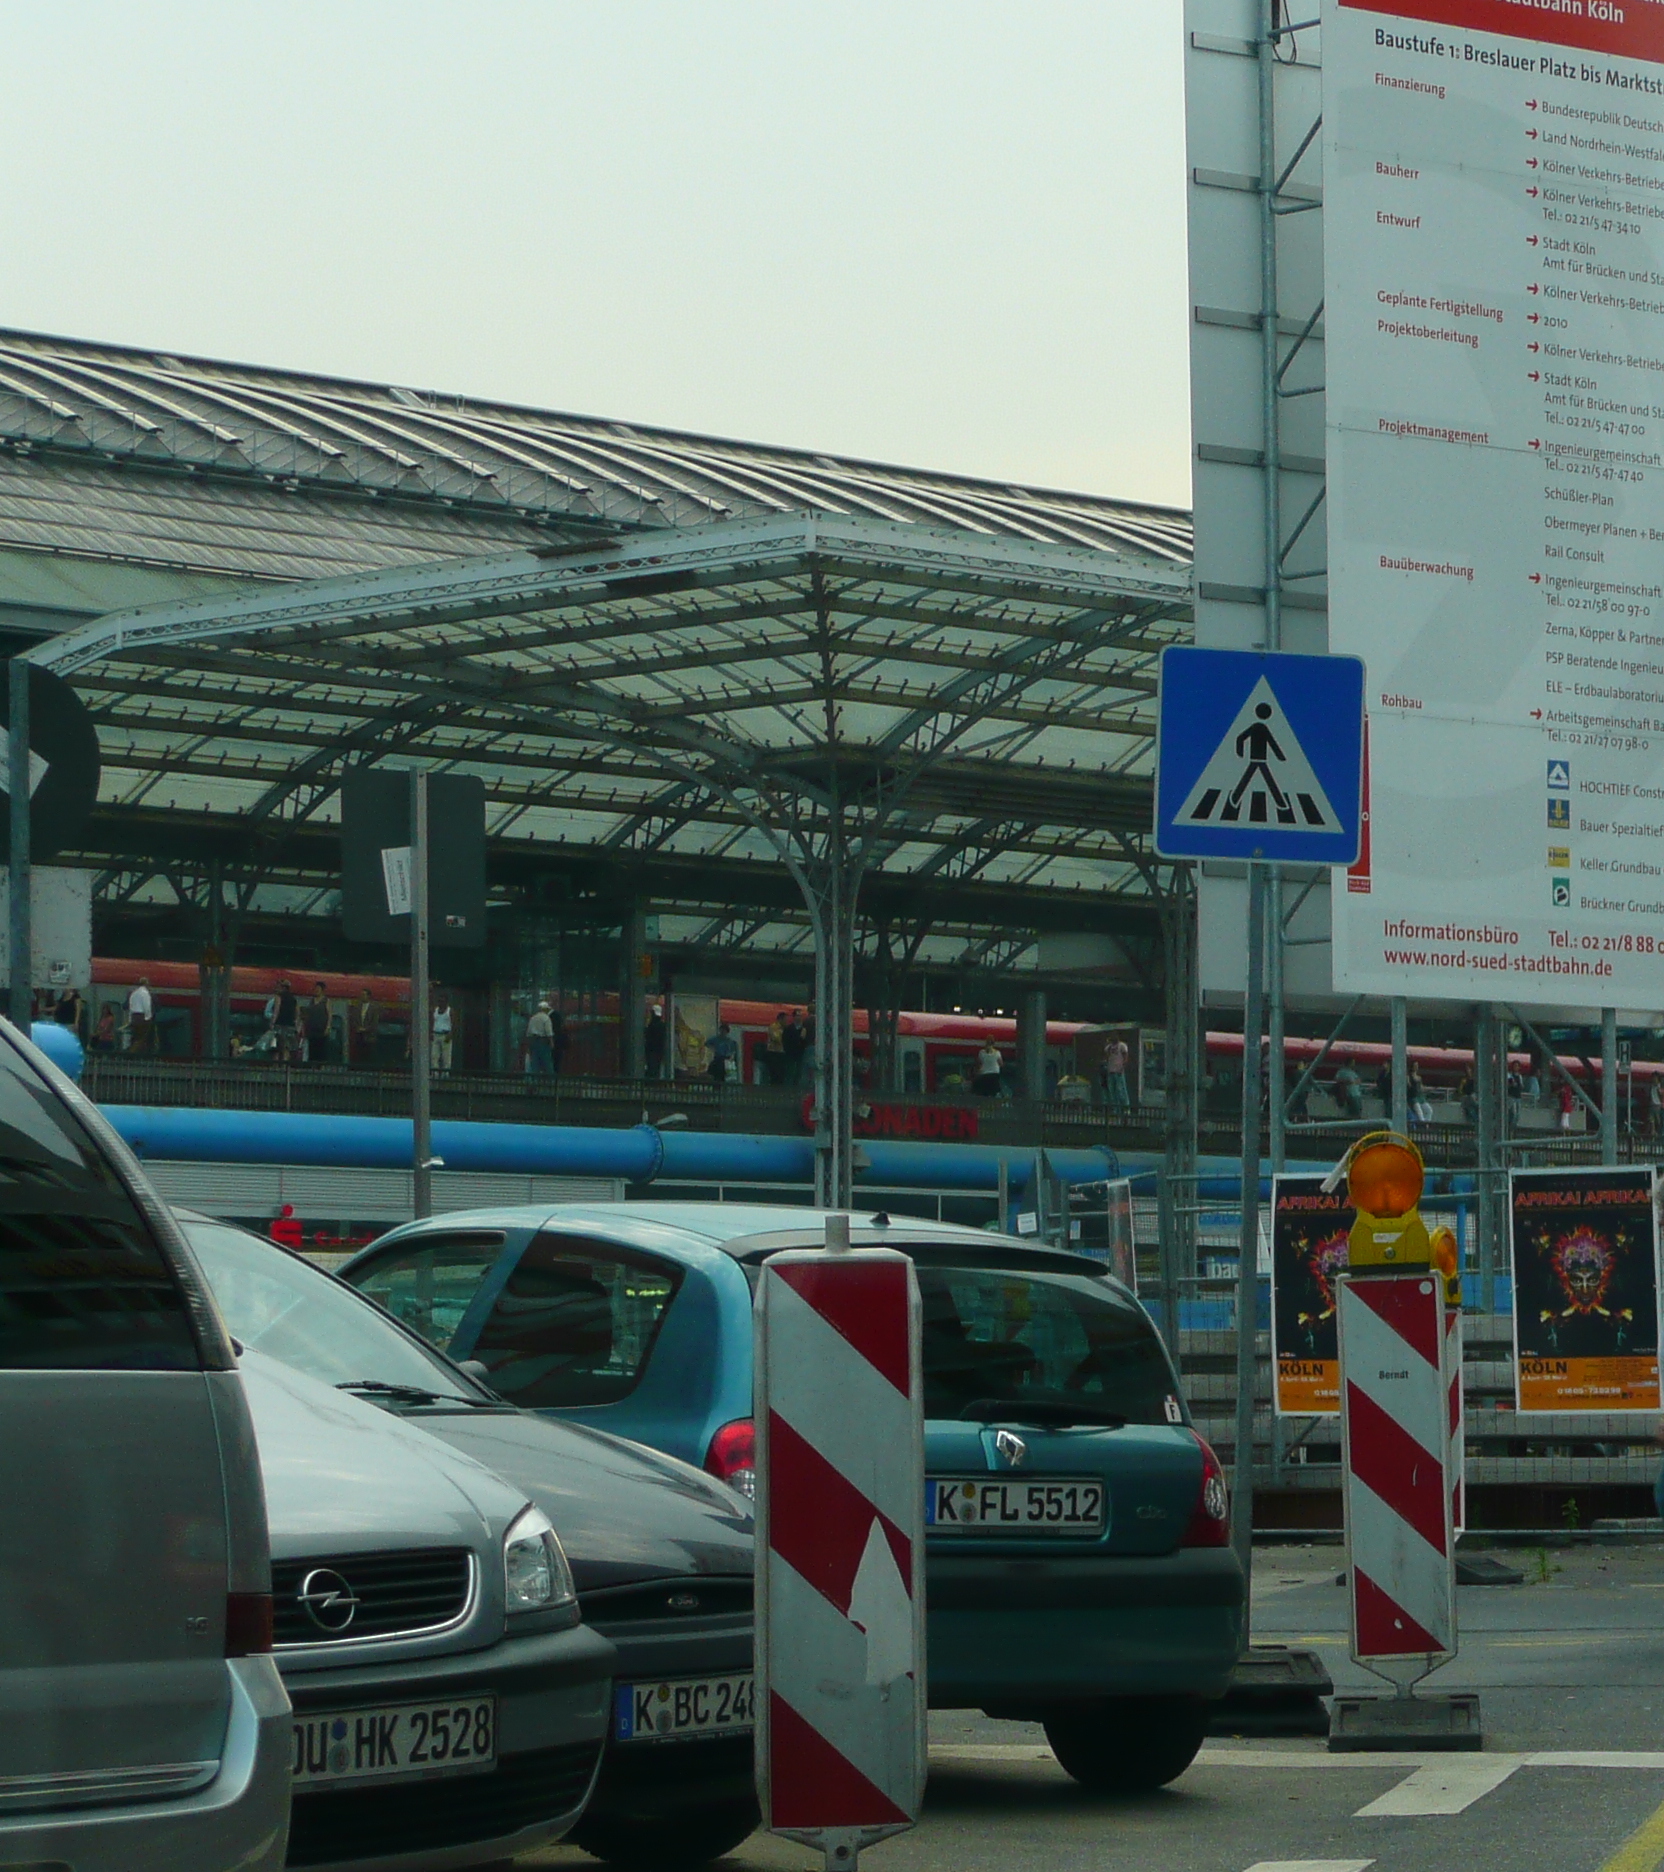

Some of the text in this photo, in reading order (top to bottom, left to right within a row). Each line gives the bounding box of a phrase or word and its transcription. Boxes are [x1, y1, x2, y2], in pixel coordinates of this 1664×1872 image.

[1588, 1, 1624, 24] Köln
[1375, 28, 1445, 57] Baustufe
[1449, 44, 1460, 60] 1:
[1464, 43, 1536, 73] Breslauer
[1540, 57, 1576, 79] Platz
[1581, 62, 1601, 84] bis
[1375, 72, 1446, 99] Finanzierung
[1542, 100, 1621, 126] Bundesrepublik
[1542, 130, 1567, 146] Land
[1376, 161, 1419, 180] Bauherr
[1542, 158, 1575, 176] Kölner
[1542, 187, 1575, 205] Kölner
[1376, 211, 1421, 229] Entwurf
[1542, 207, 1563, 222] Tel.:
[1564, 213, 1577, 224] 02
[1543, 236, 1596, 256] Stadt Köln
[1543, 256, 1565, 271] Amt
[1568, 259, 1583, 274] für
[1586, 263, 1626, 280] Brücken
[1629, 270, 1648, 283] und
[1543, 284, 1577, 301] Kölner
[1377, 290, 1504, 323] Geplante Fertigstellung
[1544, 316, 1568, 329] 2010
[1378, 319, 1479, 349] Projektoberleitung
[1544, 343, 1576, 359] Kölner
[1544, 372, 1597, 390] Stadt Köln
[1544, 391, 1566, 406] Amt
[1569, 394, 1584, 408] für
[1587, 397, 1627, 414] Brücken
[1630, 405, 1649, 417] und
[1544, 411, 1565, 426] Tel.:
[1567, 416, 1579, 427] 02
[1379, 418, 1489, 445] Projektmanagement
[1545, 440, 1661, 466] Ingenieurgemeinschaft
[1567, 463, 1579, 473] 02
[1544, 516, 1601, 536] Obermeyer
[1603, 522, 1637, 538] Planen
[1640, 530, 1646, 539] +
[1545, 545, 1604, 563] Rail Consult
[1380, 555, 1474, 580] Bauüberwachung
[1546, 574, 1661, 598] Ingenieurgemeinschaft
[1567, 598, 1580, 609] 02
[1546, 622, 1664, 647] Zerna, Köpper & Partner
[1546, 651, 1564, 665] PSP
[1567, 653, 1618, 671] Beratende
[1546, 680, 1563, 693] ELE
[1381, 694, 1422, 710] Rohbau
[1546, 709, 1650, 731] Arbeitsgemeinschaft
[1569, 733, 1581, 744] 02
[1580, 781, 1630, 797] HOCHTIEF
[1580, 819, 1609, 833] Bauer
[1580, 858, 1609, 871] Keller
[1611, 860, 1661, 876] Grundbau
[1580, 896, 1625, 911] Brückner
[1384, 919, 1519, 945] Informationsbüro
[1549, 930, 1578, 949] Tel.:
[1581, 935, 1600, 950] 02
[1603, 934, 1633, 953] 21/8
[1636, 935, 1654, 953] 88
[1384, 949, 1613, 977] www.nord-sued-stadtbahn.de
[1280, 1361, 1324, 1376] KÖLN
[1378, 1370, 1409, 1380] Berndt
[1521, 1359, 1568, 1374] KÖLN
[937, 1485, 958, 1521] K
[980, 1486, 1019, 1521] FL
[1027, 1487, 1100, 1522] 5512
[636, 1689, 655, 1732] K
[674, 1684, 710, 1727] BC
[355, 1714, 399, 1769] HK
[409, 1704, 491, 1764] 2528
